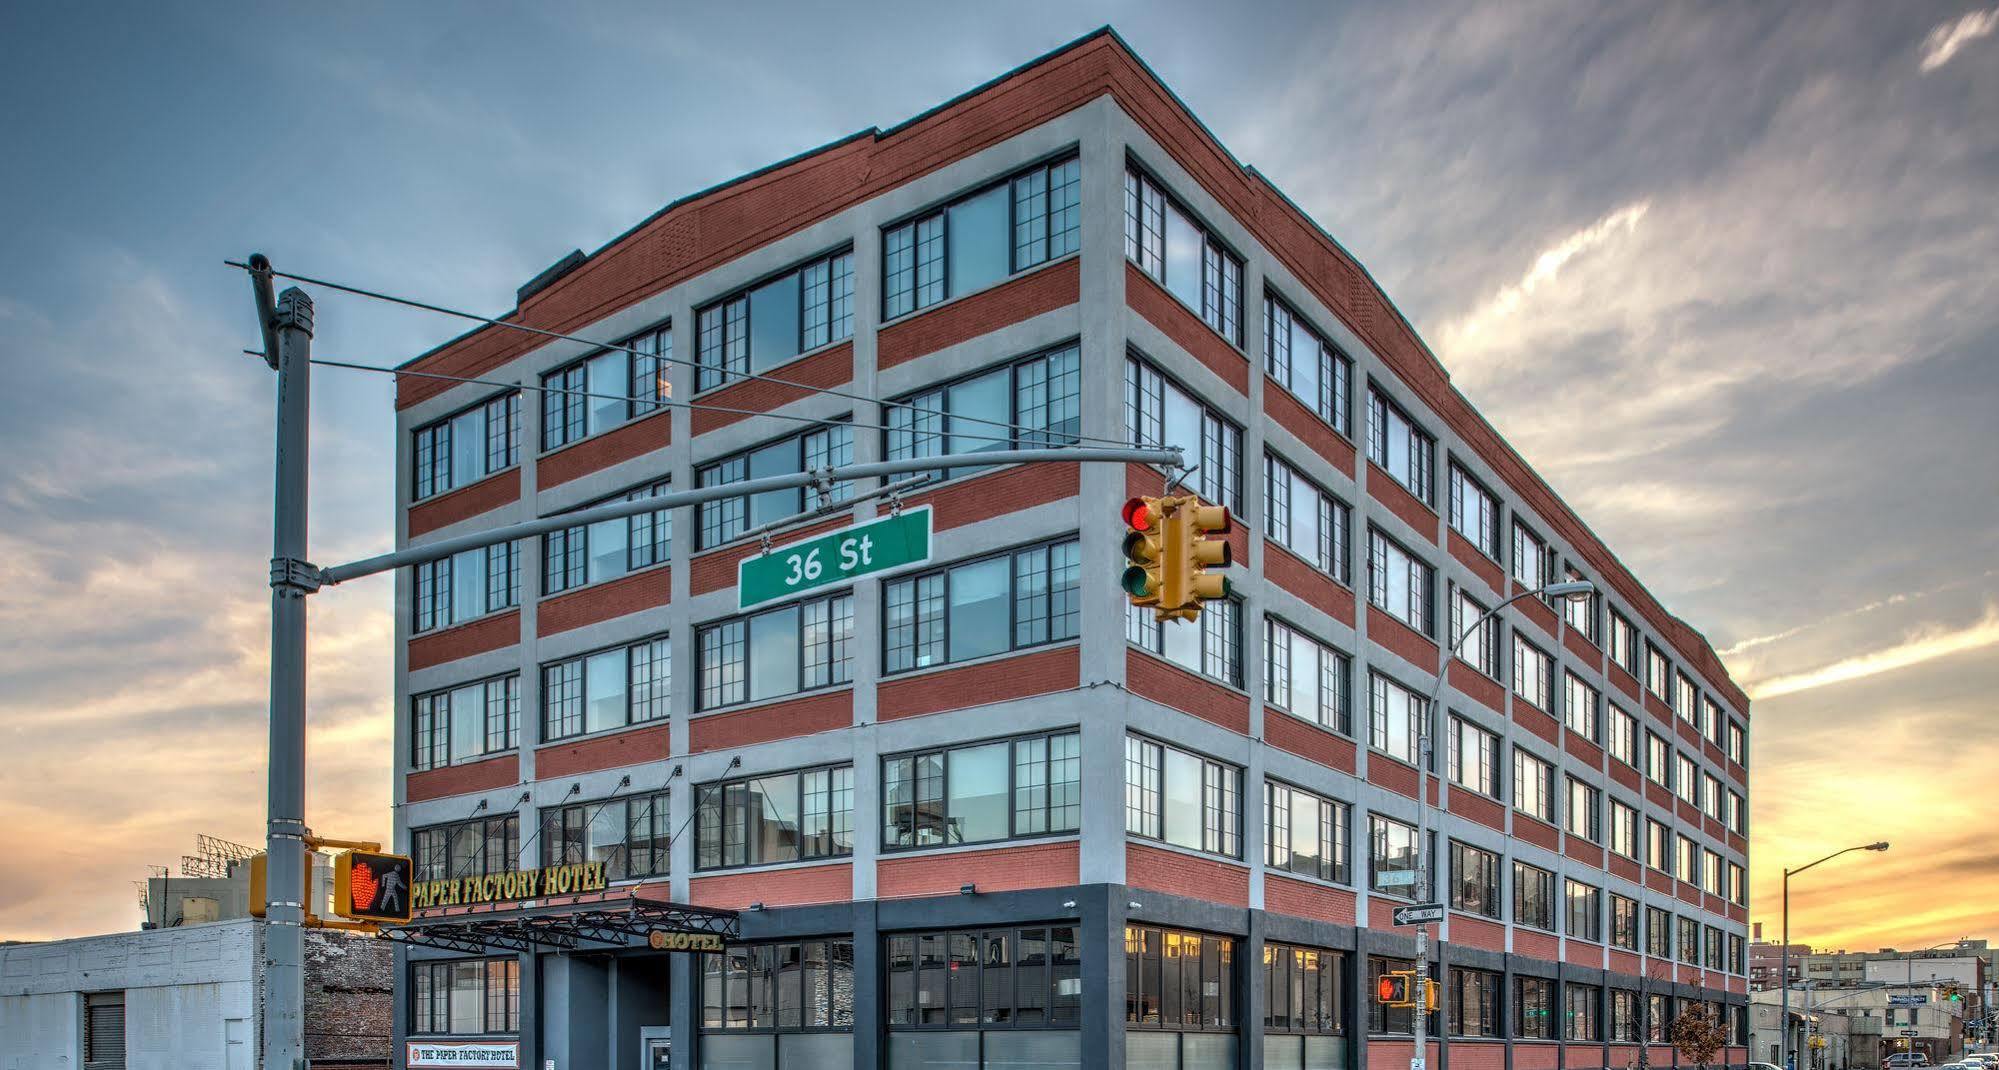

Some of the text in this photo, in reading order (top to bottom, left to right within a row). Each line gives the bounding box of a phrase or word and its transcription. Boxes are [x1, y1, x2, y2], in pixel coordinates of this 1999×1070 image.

[784, 533, 873, 586] 36 St
[411, 860, 607, 908] PAPER FACTORY HOTEL
[1399, 909, 1436, 921] ONE WAY
[662, 932, 725, 951] HOTEL
[421, 1049, 515, 1061] THE PAPER FACTORY HOTEL
